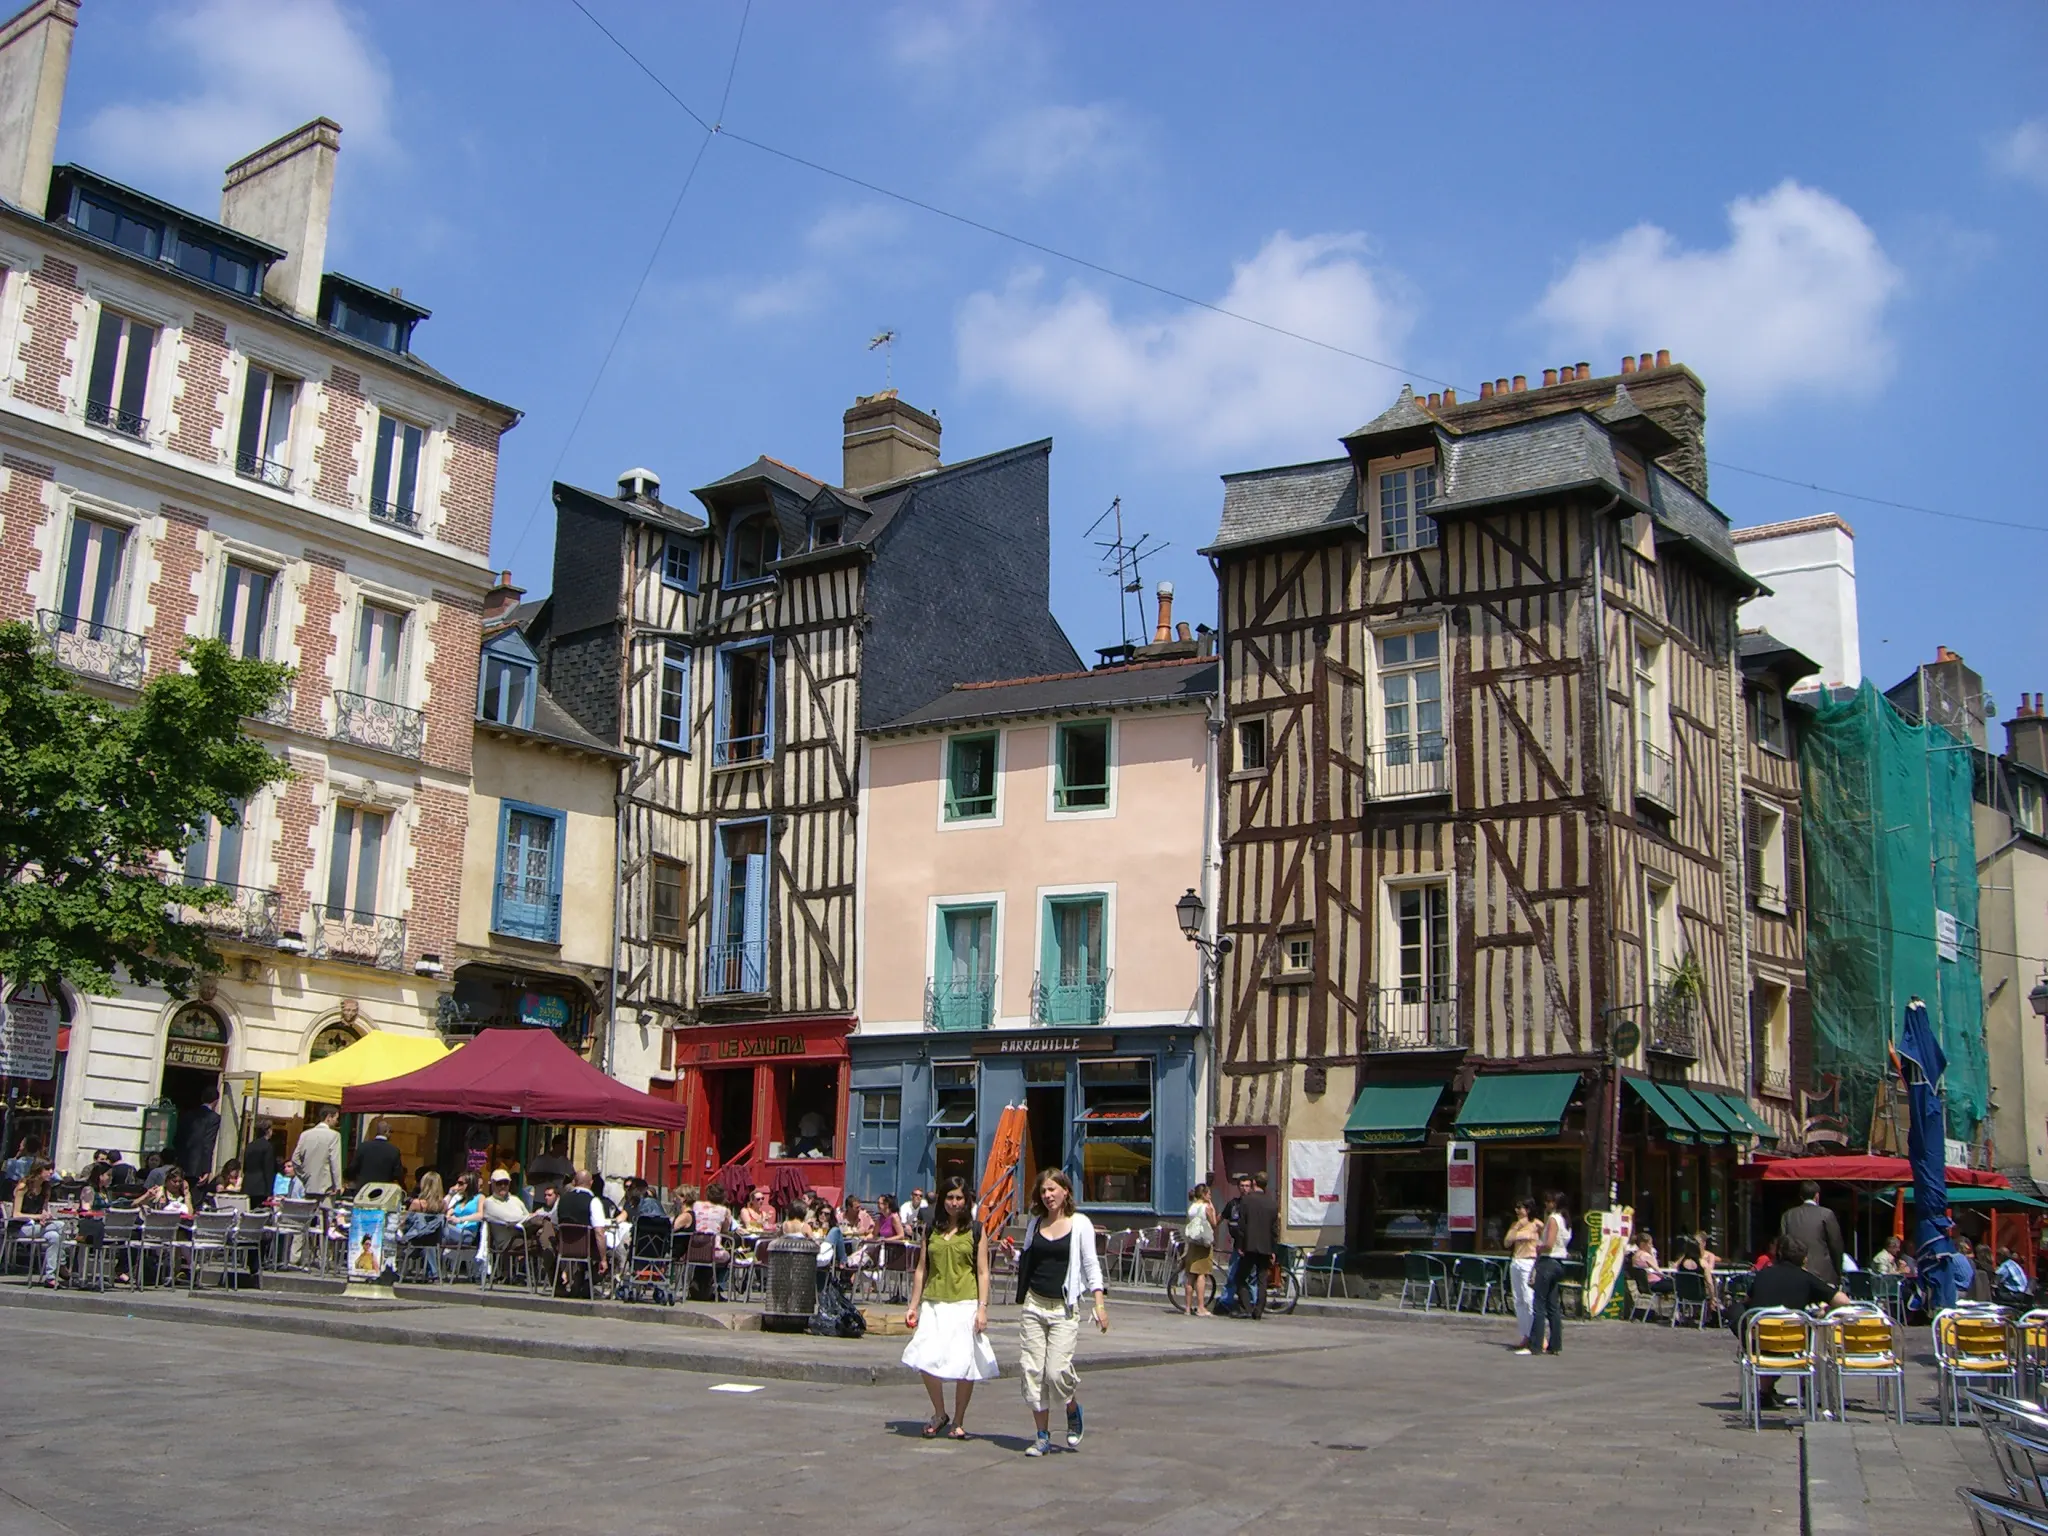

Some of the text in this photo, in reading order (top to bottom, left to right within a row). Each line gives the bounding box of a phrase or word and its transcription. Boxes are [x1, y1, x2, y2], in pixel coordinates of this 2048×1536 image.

[719, 1034, 805, 1058] LE SALMA
[1000, 1037, 1080, 1052] BARROUILLE
[166, 1051, 222, 1067] AU BUREAU
